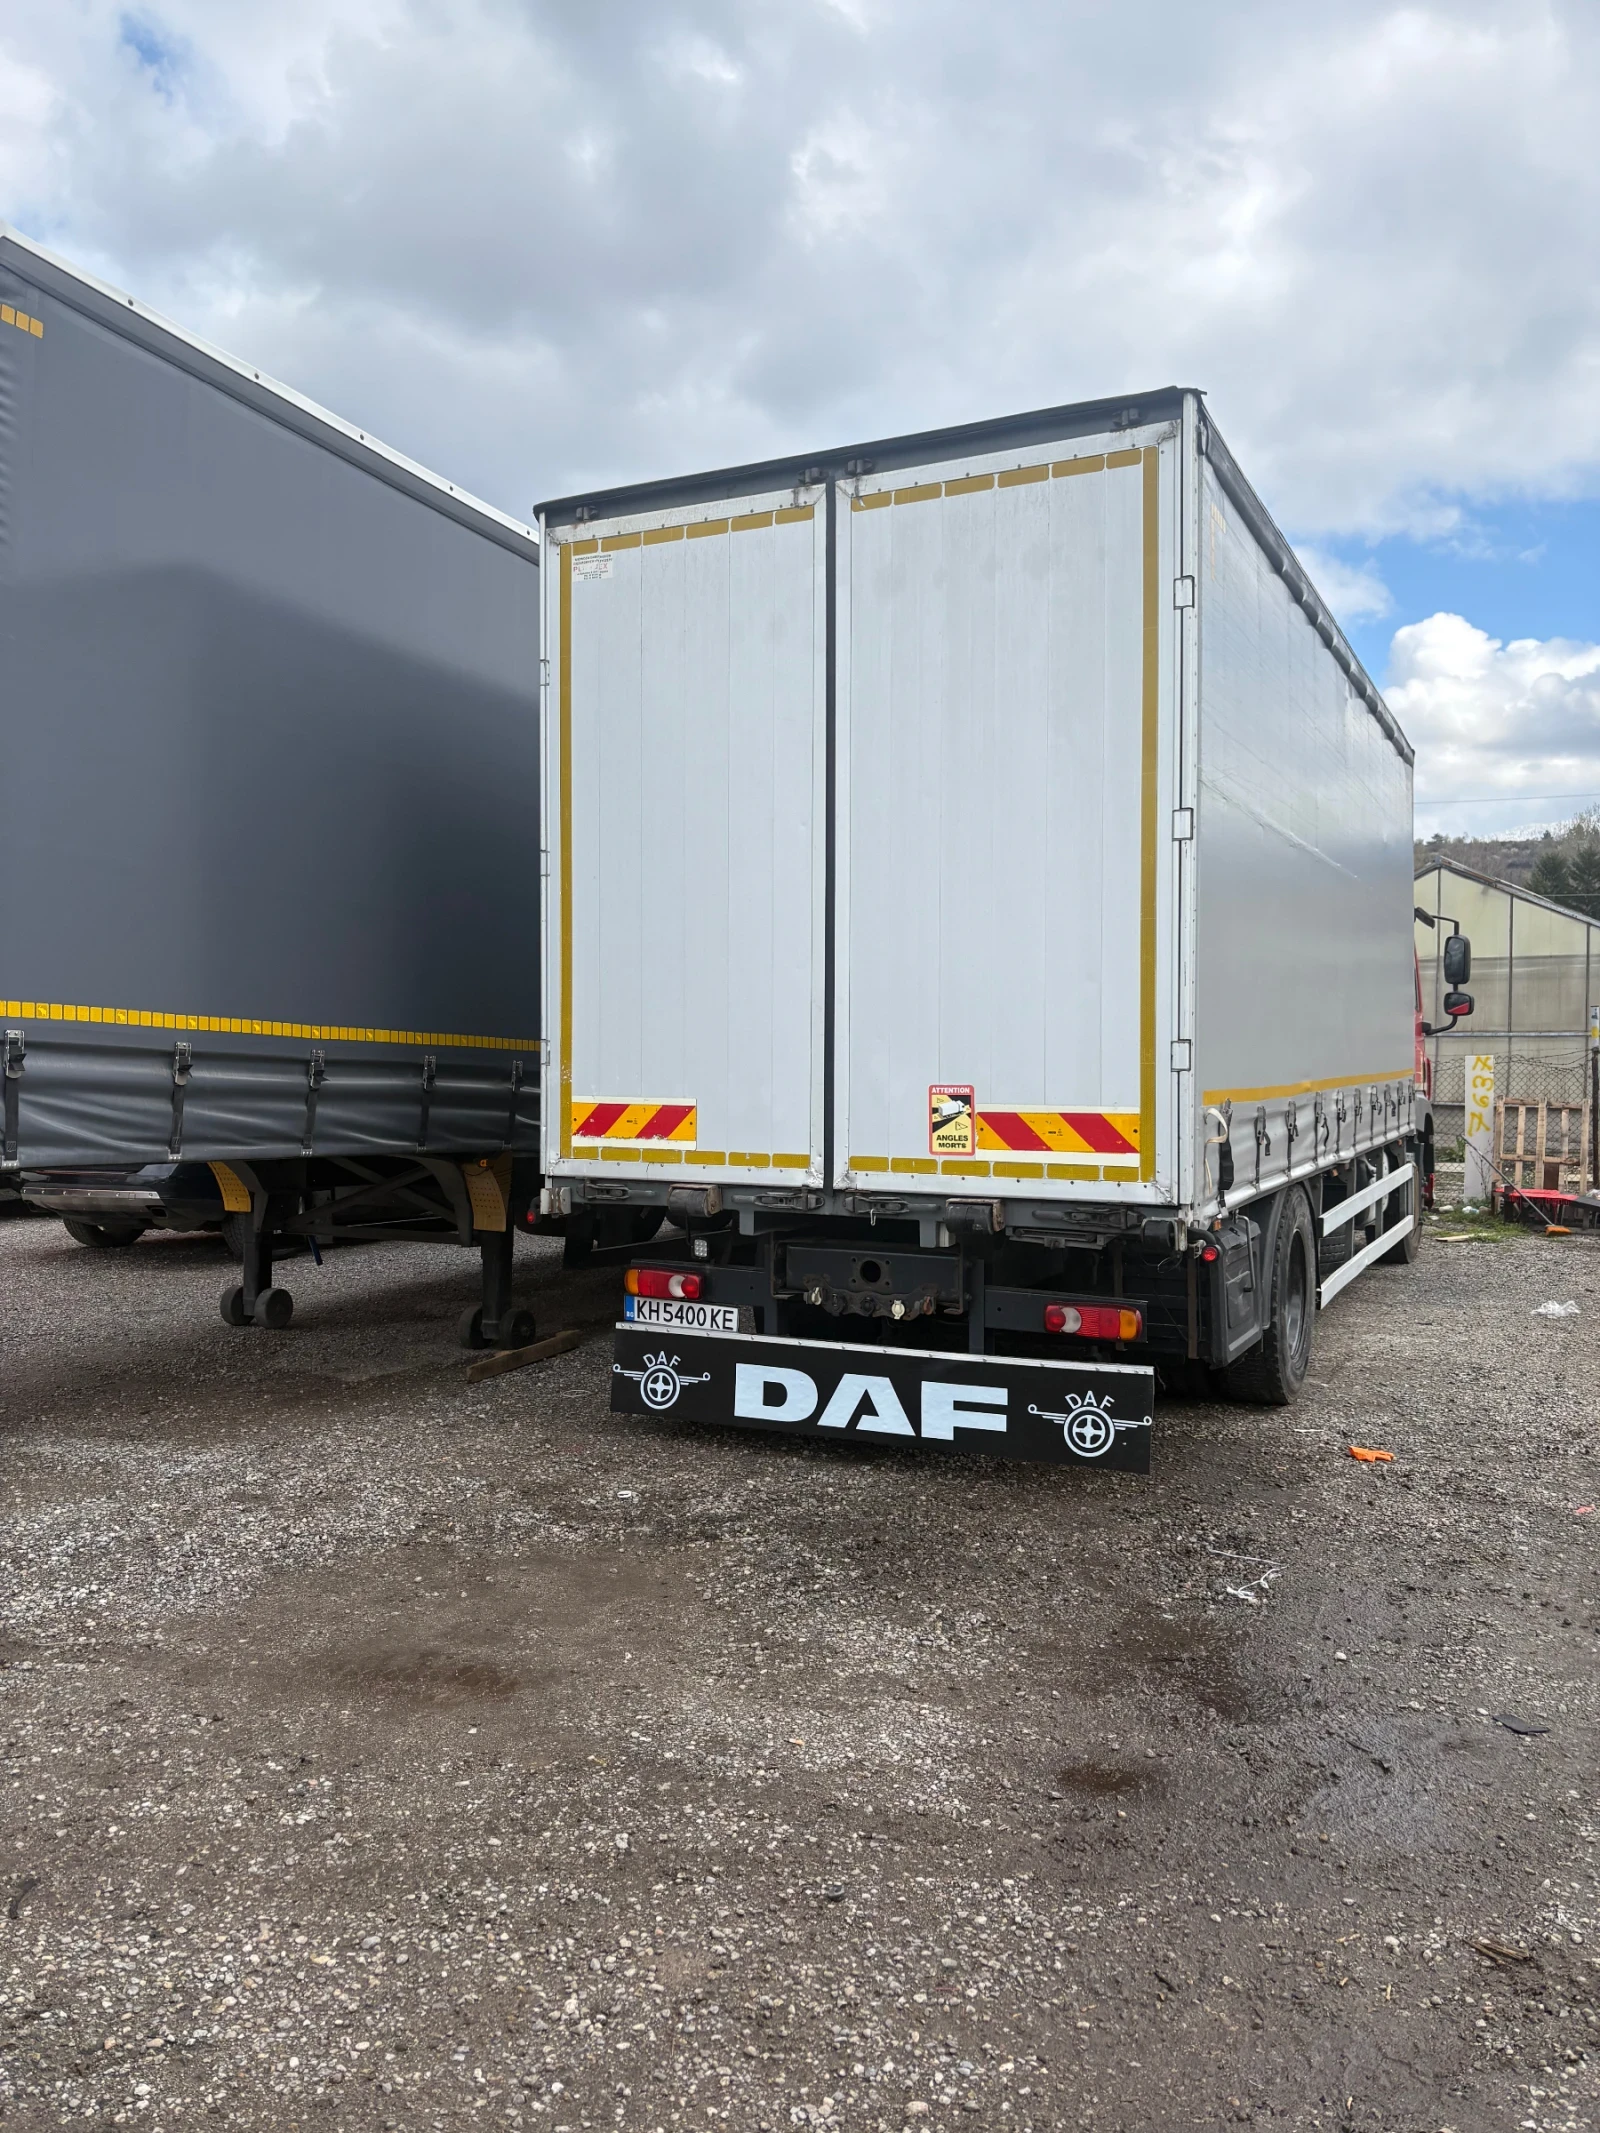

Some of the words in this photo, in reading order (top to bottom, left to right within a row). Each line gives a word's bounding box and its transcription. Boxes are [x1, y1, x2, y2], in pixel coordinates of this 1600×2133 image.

[936, 1134, 969, 1142] ANGLES
[643, 1350, 681, 1368] DAF
[734, 1363, 1009, 1441] DAF
[1065, 1390, 1115, 1410] DAF
